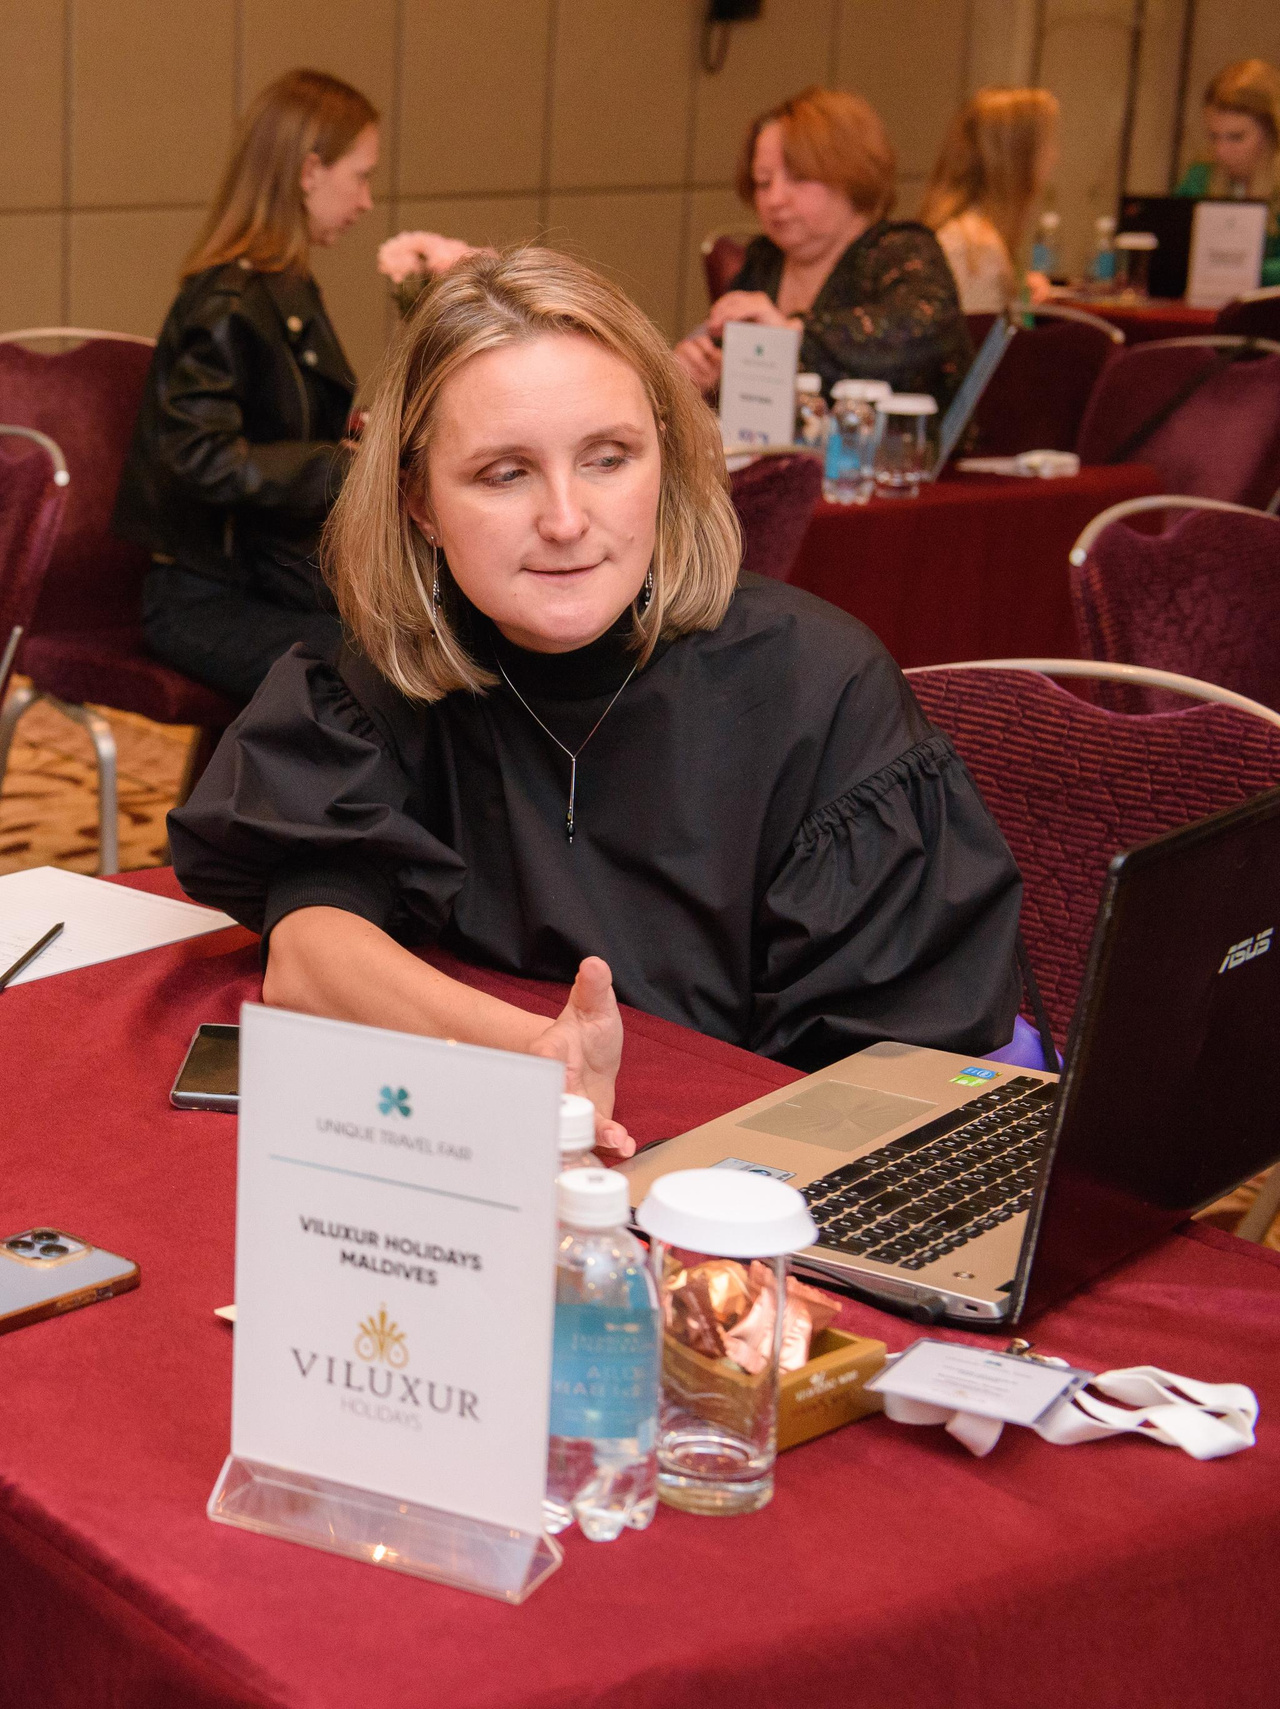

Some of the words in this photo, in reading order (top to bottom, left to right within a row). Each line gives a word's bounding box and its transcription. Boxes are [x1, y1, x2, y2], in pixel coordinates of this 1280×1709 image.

[1218, 927, 1274, 974] ASUS
[316, 1117, 375, 1143] UNIQUE
[379, 1128, 433, 1155] TRAVEL
[436, 1140, 473, 1161] FAIR
[299, 1214, 380, 1247] VILUXUR
[384, 1234, 483, 1272] HOLIDAYS
[340, 1250, 438, 1286] MALDIVES
[291, 1347, 480, 1423] VILUXUR
[340, 1397, 422, 1430] HOLIDAYS
